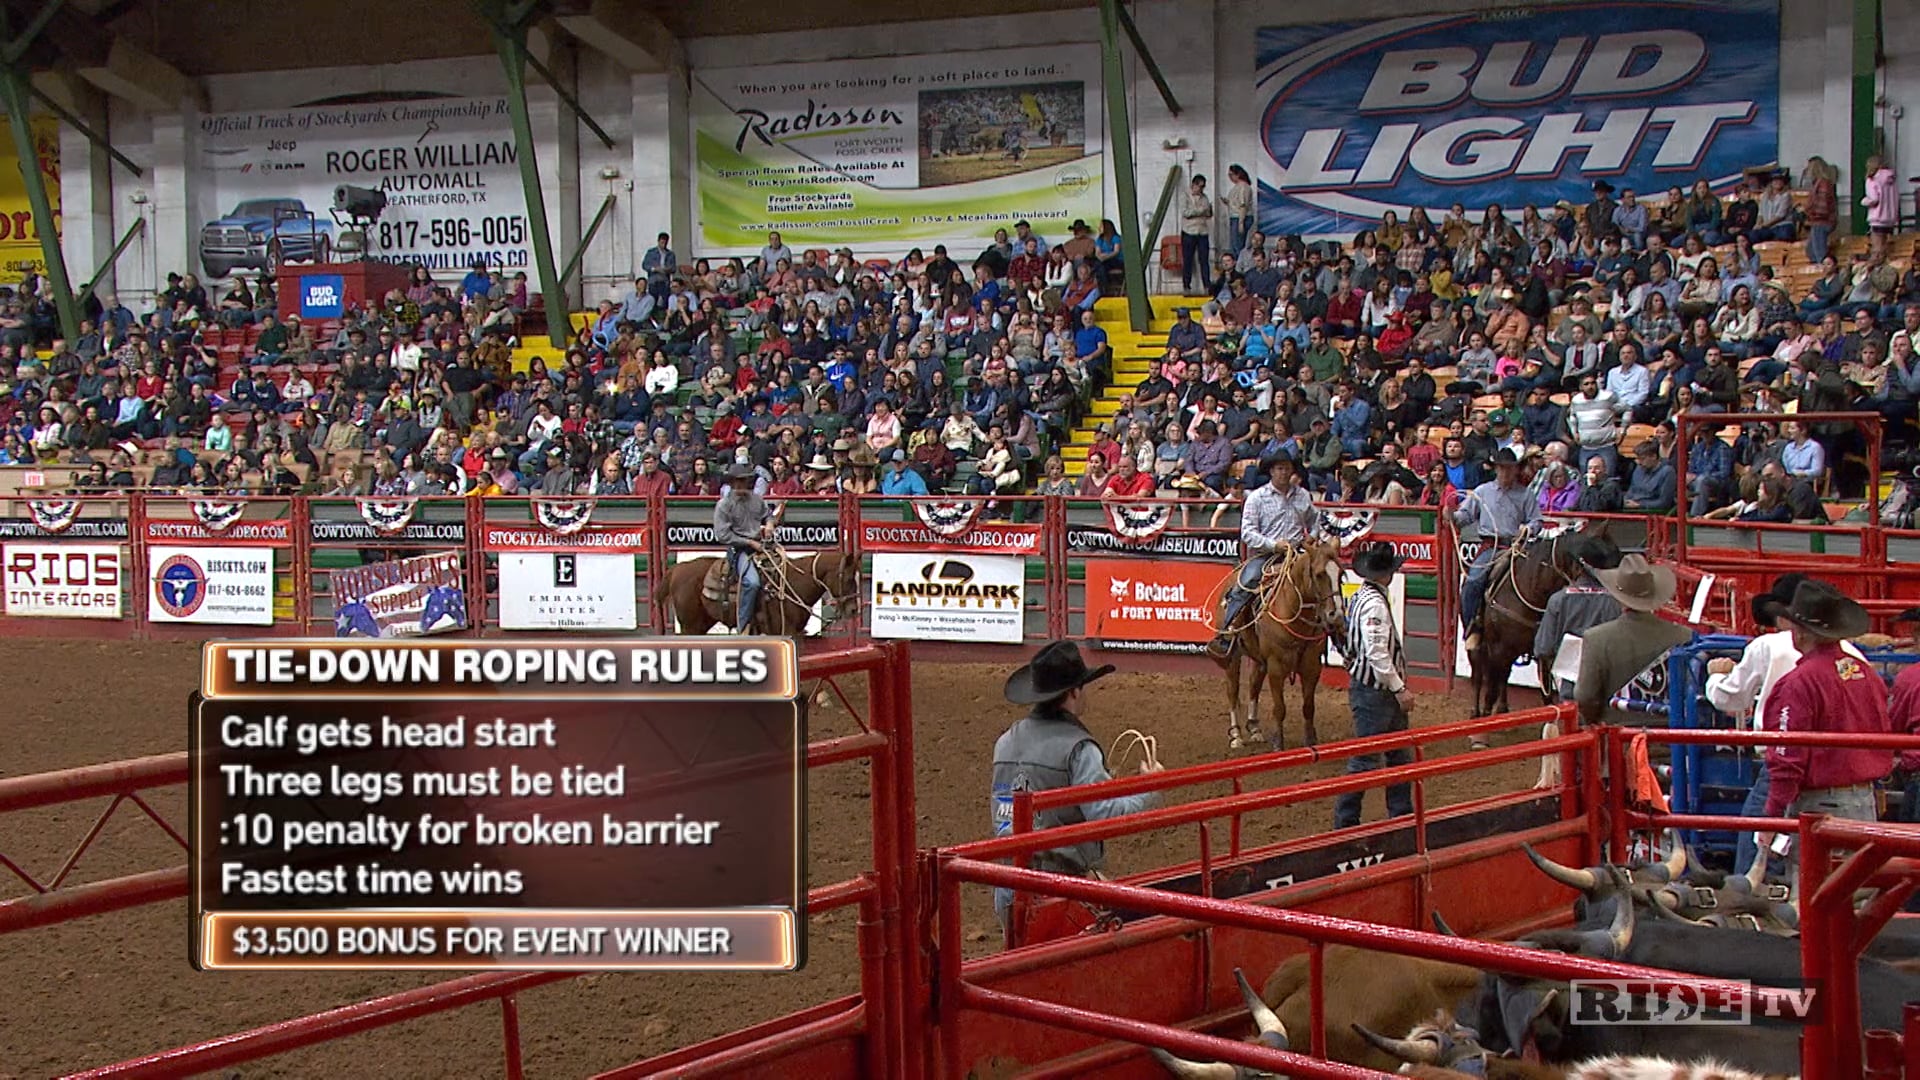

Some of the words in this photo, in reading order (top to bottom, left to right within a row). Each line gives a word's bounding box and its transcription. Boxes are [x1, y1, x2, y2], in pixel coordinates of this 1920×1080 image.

[1358, 29, 1707, 113] BUD
[781, 82, 805, 94] you
[810, 82, 831, 90] are
[835, 78, 887, 90] looking
[893, 75, 911, 85] for
[930, 72, 957, 82] soft
[962, 70, 999, 83] place
[1004, 68, 1019, 78] to
[201, 116, 251, 136] Official
[256, 114, 296, 129] Truck
[298, 113, 312, 129] of
[315, 106, 387, 128] Stockyards
[392, 101, 491, 122] Championship
[735, 98, 903, 154] Radisson
[267, 140, 297, 152] Jeep
[834, 139, 860, 149] FORT
[863, 137, 904, 148] WORTH
[1281, 100, 1757, 190] LIGHT
[326, 147, 408, 174] ROGER
[414, 141, 517, 170] WILLIAM
[718, 169, 760, 179] Special
[763, 167, 795, 175] Room
[797, 165, 829, 174] Rates
[834, 161, 888, 172] Available
[891, 161, 905, 169] At
[380, 171, 486, 193] AUTOMALL
[747, 174, 875, 188] StockyardsRodeo.com
[472, 192, 486, 202] TX
[769, 195, 792, 203] Free
[794, 192, 852, 203] Stockyards
[768, 203, 804, 212] Shuttle
[807, 202, 854, 211] Available
[946, 215, 954, 223] &
[958, 212, 1009, 223] Meacham
[1012, 210, 1068, 221] Boulevard
[310, 285, 333, 297] BUD
[305, 295, 338, 306] LIGHT
[489, 531, 642, 547] STOCKYARDSRODEO.COM
[8, 553, 118, 587] RIOS
[558, 557, 573, 582] E
[876, 581, 1020, 600] LANDMARK
[1135, 581, 1185, 602] Bobcat
[10, 591, 116, 607] INTERIORS
[371, 588, 424, 614] SUPPLY
[876, 595, 1020, 609] EQUIPMENT
[878, 614, 896, 622] Irving
[902, 615, 932, 623] McKinney
[982, 617, 995, 625] Fort
[1110, 608, 1119, 618] of
[1122, 606, 1153, 620] FORT
